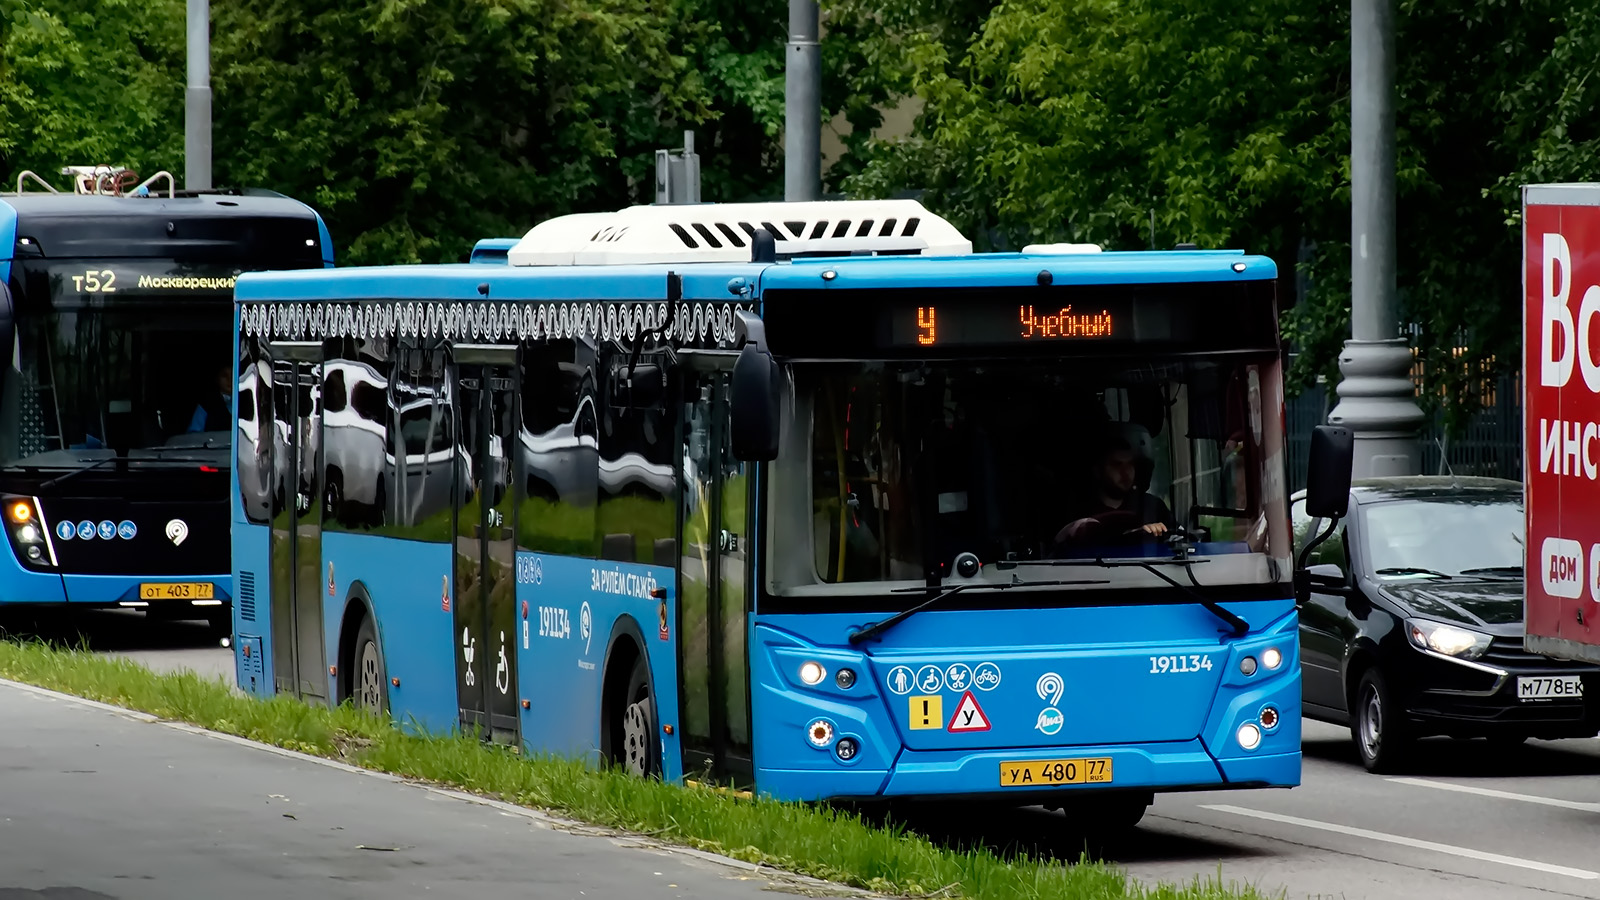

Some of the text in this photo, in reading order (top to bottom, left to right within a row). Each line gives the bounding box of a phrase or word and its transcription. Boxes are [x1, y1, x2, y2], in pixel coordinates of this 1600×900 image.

[918, 304, 1111, 345] У Учебный
[1539, 418, 1600, 481] ИНС
[591, 568, 601, 591] ЗА
[601, 566, 626, 596] РУЛЁМ
[1549, 554, 1577, 584] ДОМ
[167, 584, 190, 597] 403
[197, 584, 209, 594] 77
[538, 605, 571, 640] 191134
[1149, 654, 1213, 674] 191134
[1010, 760, 1106, 783] УА 480 77
